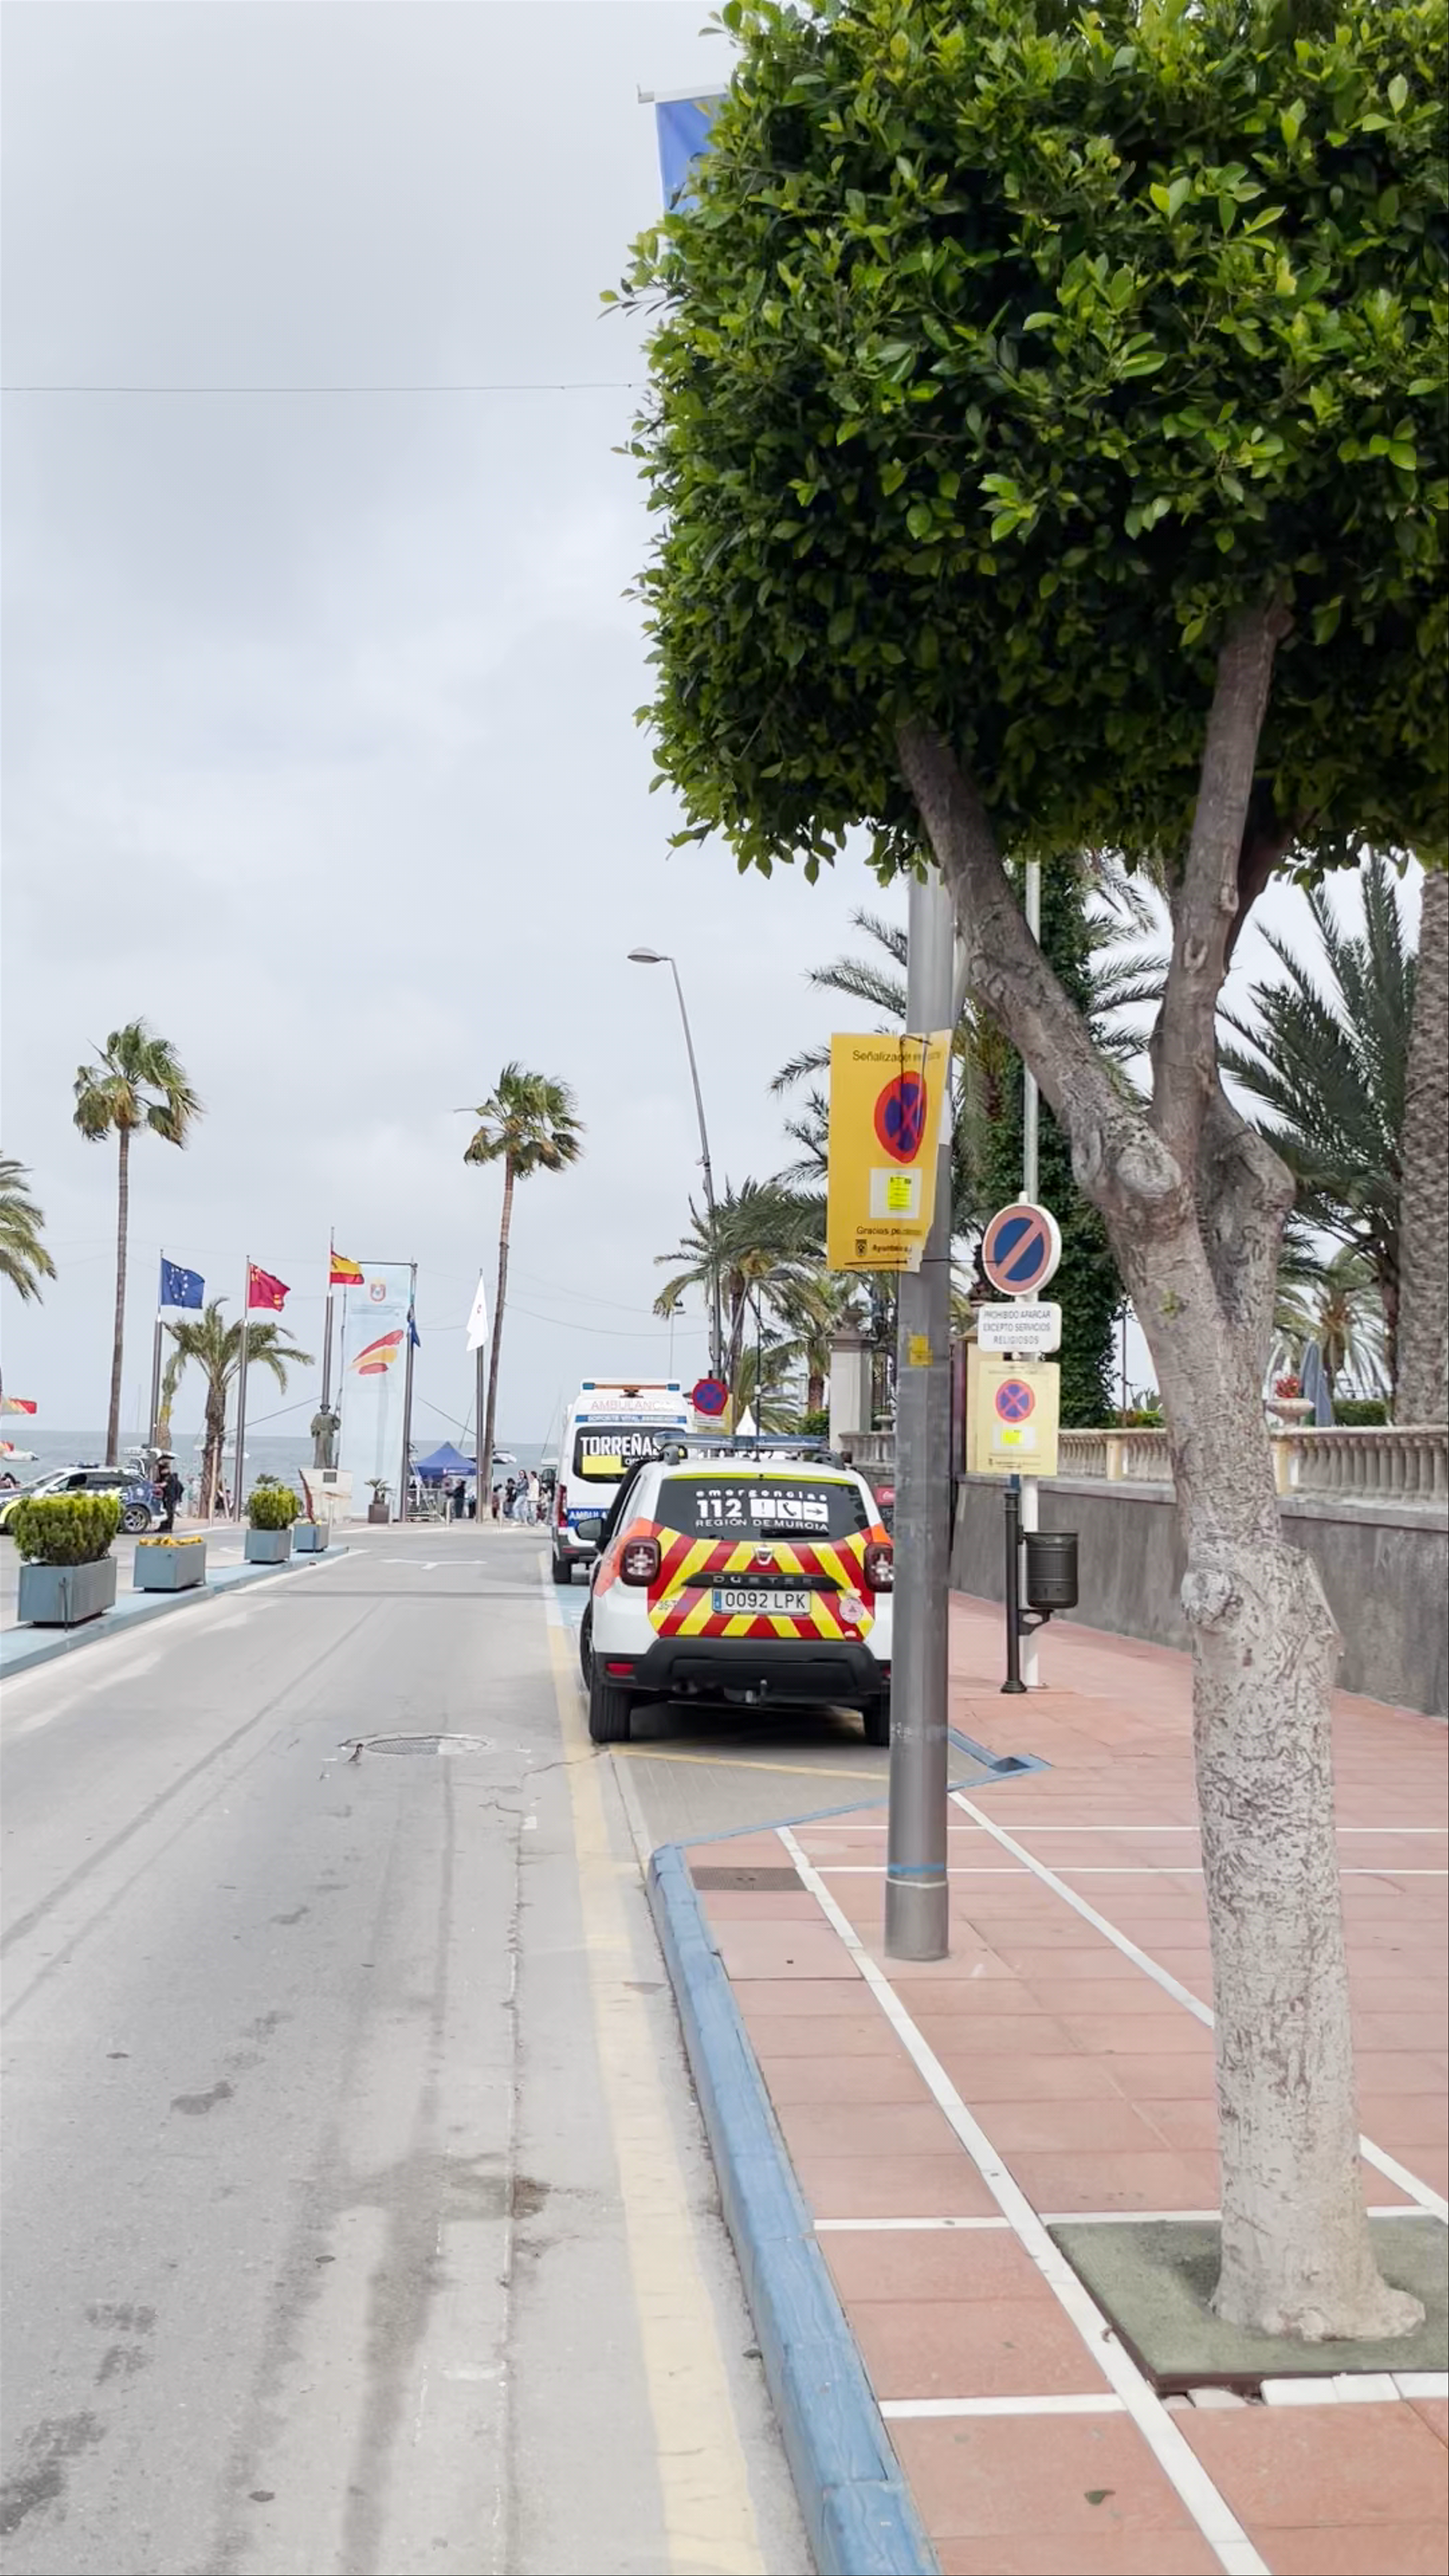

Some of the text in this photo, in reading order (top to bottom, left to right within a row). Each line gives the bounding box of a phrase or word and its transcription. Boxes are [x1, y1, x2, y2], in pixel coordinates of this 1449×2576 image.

[852, 1050, 911, 1063] Señalizac
[856, 1226, 889, 1235] Gracias
[984, 1310, 1051, 1319] PROHIBIDO APARCAR
[983, 1323, 1051, 1332] EXCEPTO SERVICIOS
[994, 1335, 1039, 1344] RELIGIOSOS
[591, 1399, 675, 1411] AMBULANC
[580, 1433, 660, 1456] TORREÑAS
[696, 1490, 827, 1501] emergencias
[697, 1498, 742, 1518] 112
[774, 1521, 828, 1531] MURCIA
[725, 1592, 805, 1609] 0092 LPK
